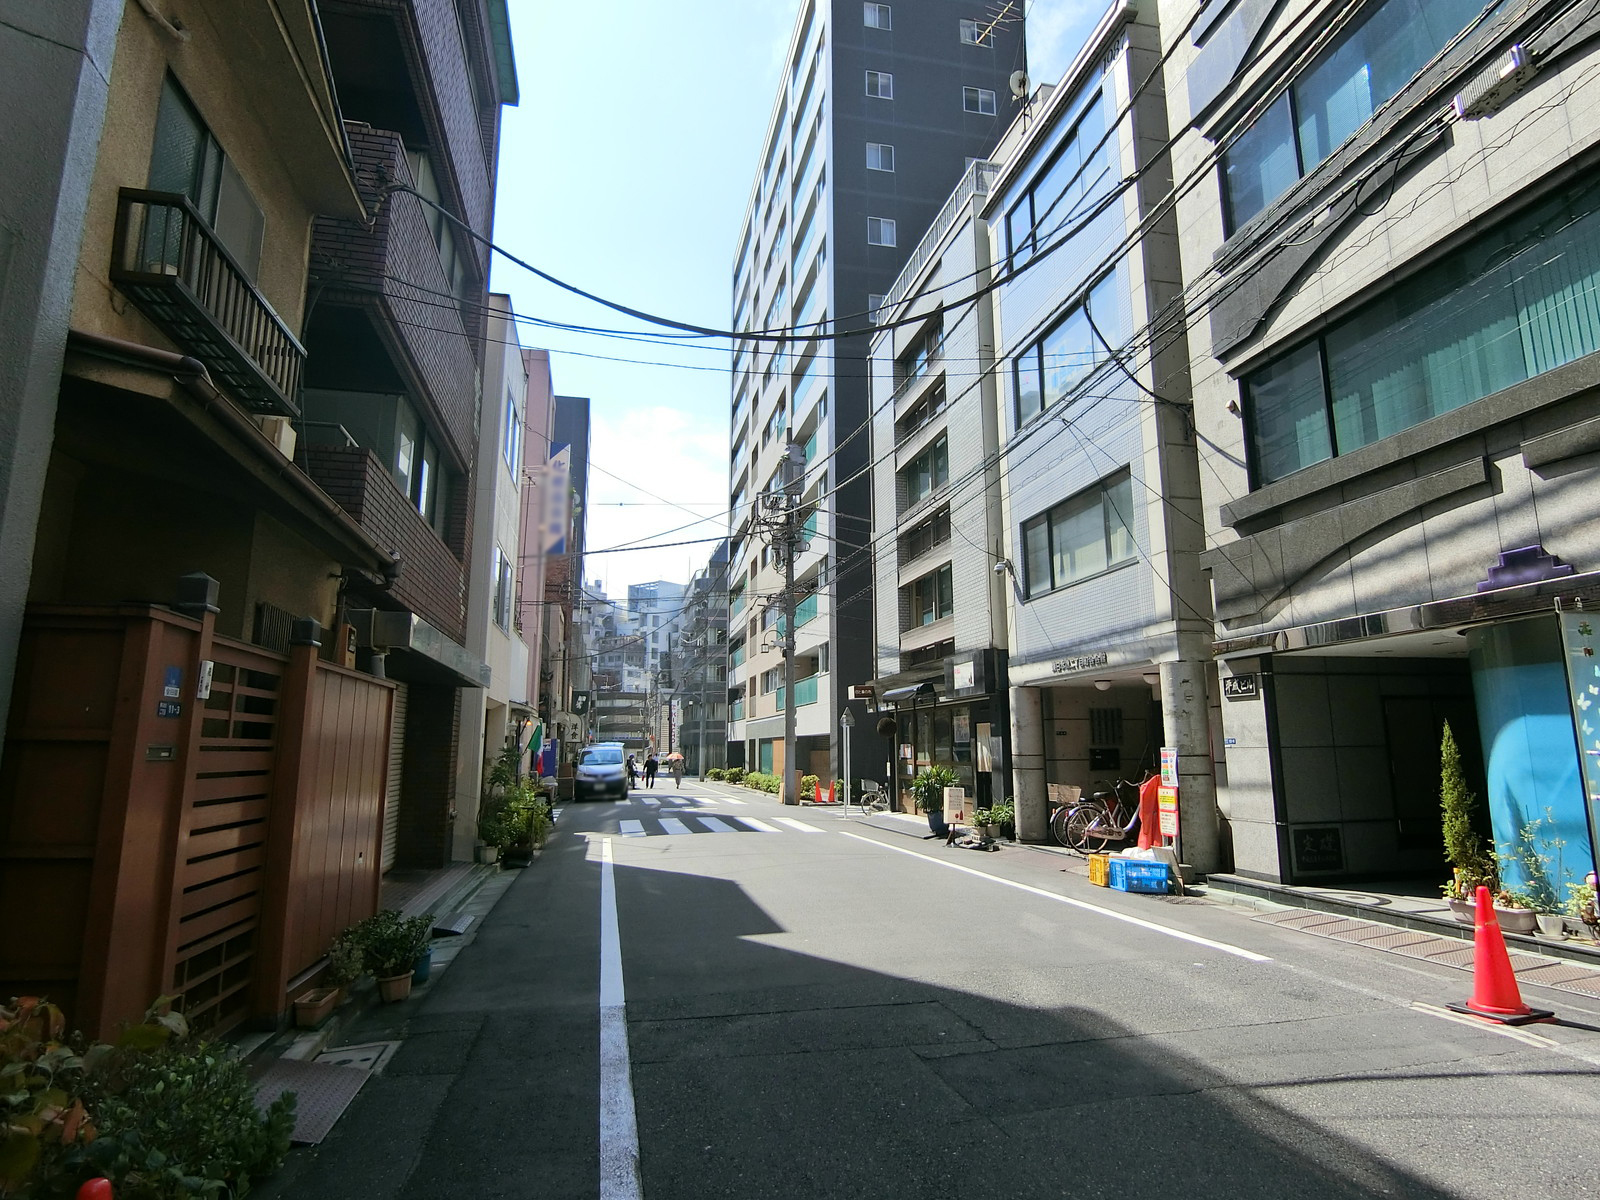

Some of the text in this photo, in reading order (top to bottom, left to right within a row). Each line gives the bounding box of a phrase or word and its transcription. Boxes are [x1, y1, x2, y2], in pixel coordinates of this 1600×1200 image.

[1102, 28, 1127, 74] 1987
[1225, 678, 1253, 694] 平成ビル
[167, 704, 181, 715] 11-3
[571, 722, 579, 740] 洋食
